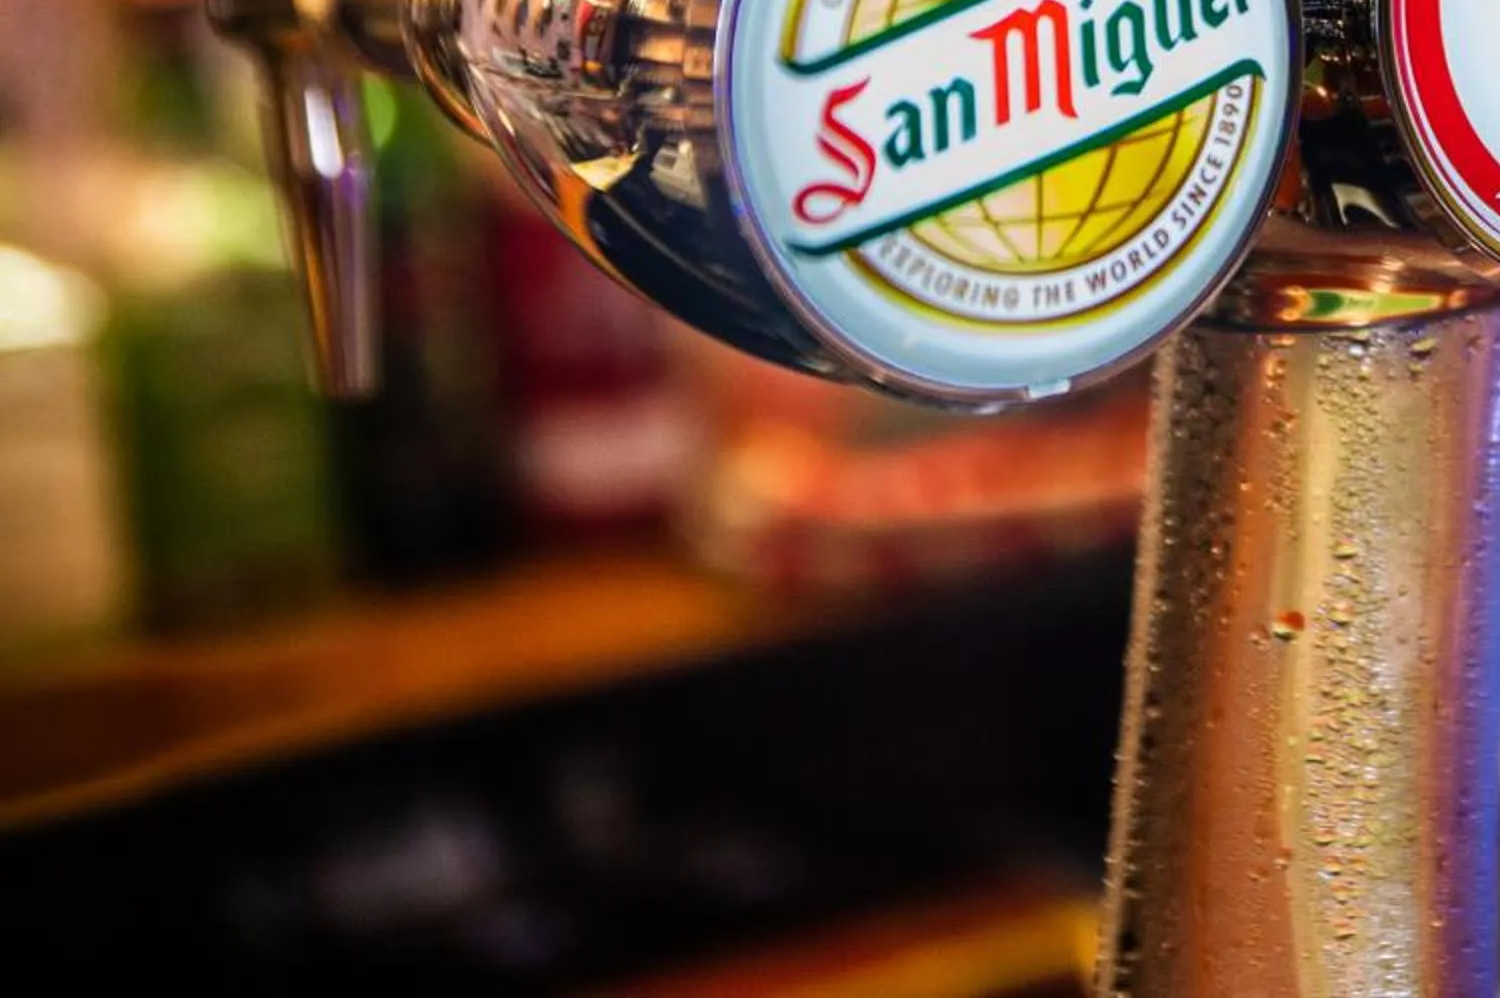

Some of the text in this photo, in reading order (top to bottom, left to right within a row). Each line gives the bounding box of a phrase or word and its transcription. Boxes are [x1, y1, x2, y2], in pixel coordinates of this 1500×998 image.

[791, 74, 977, 226] San
[879, 83, 1244, 308] EXPLORING THE WORLD SINCE 1890
